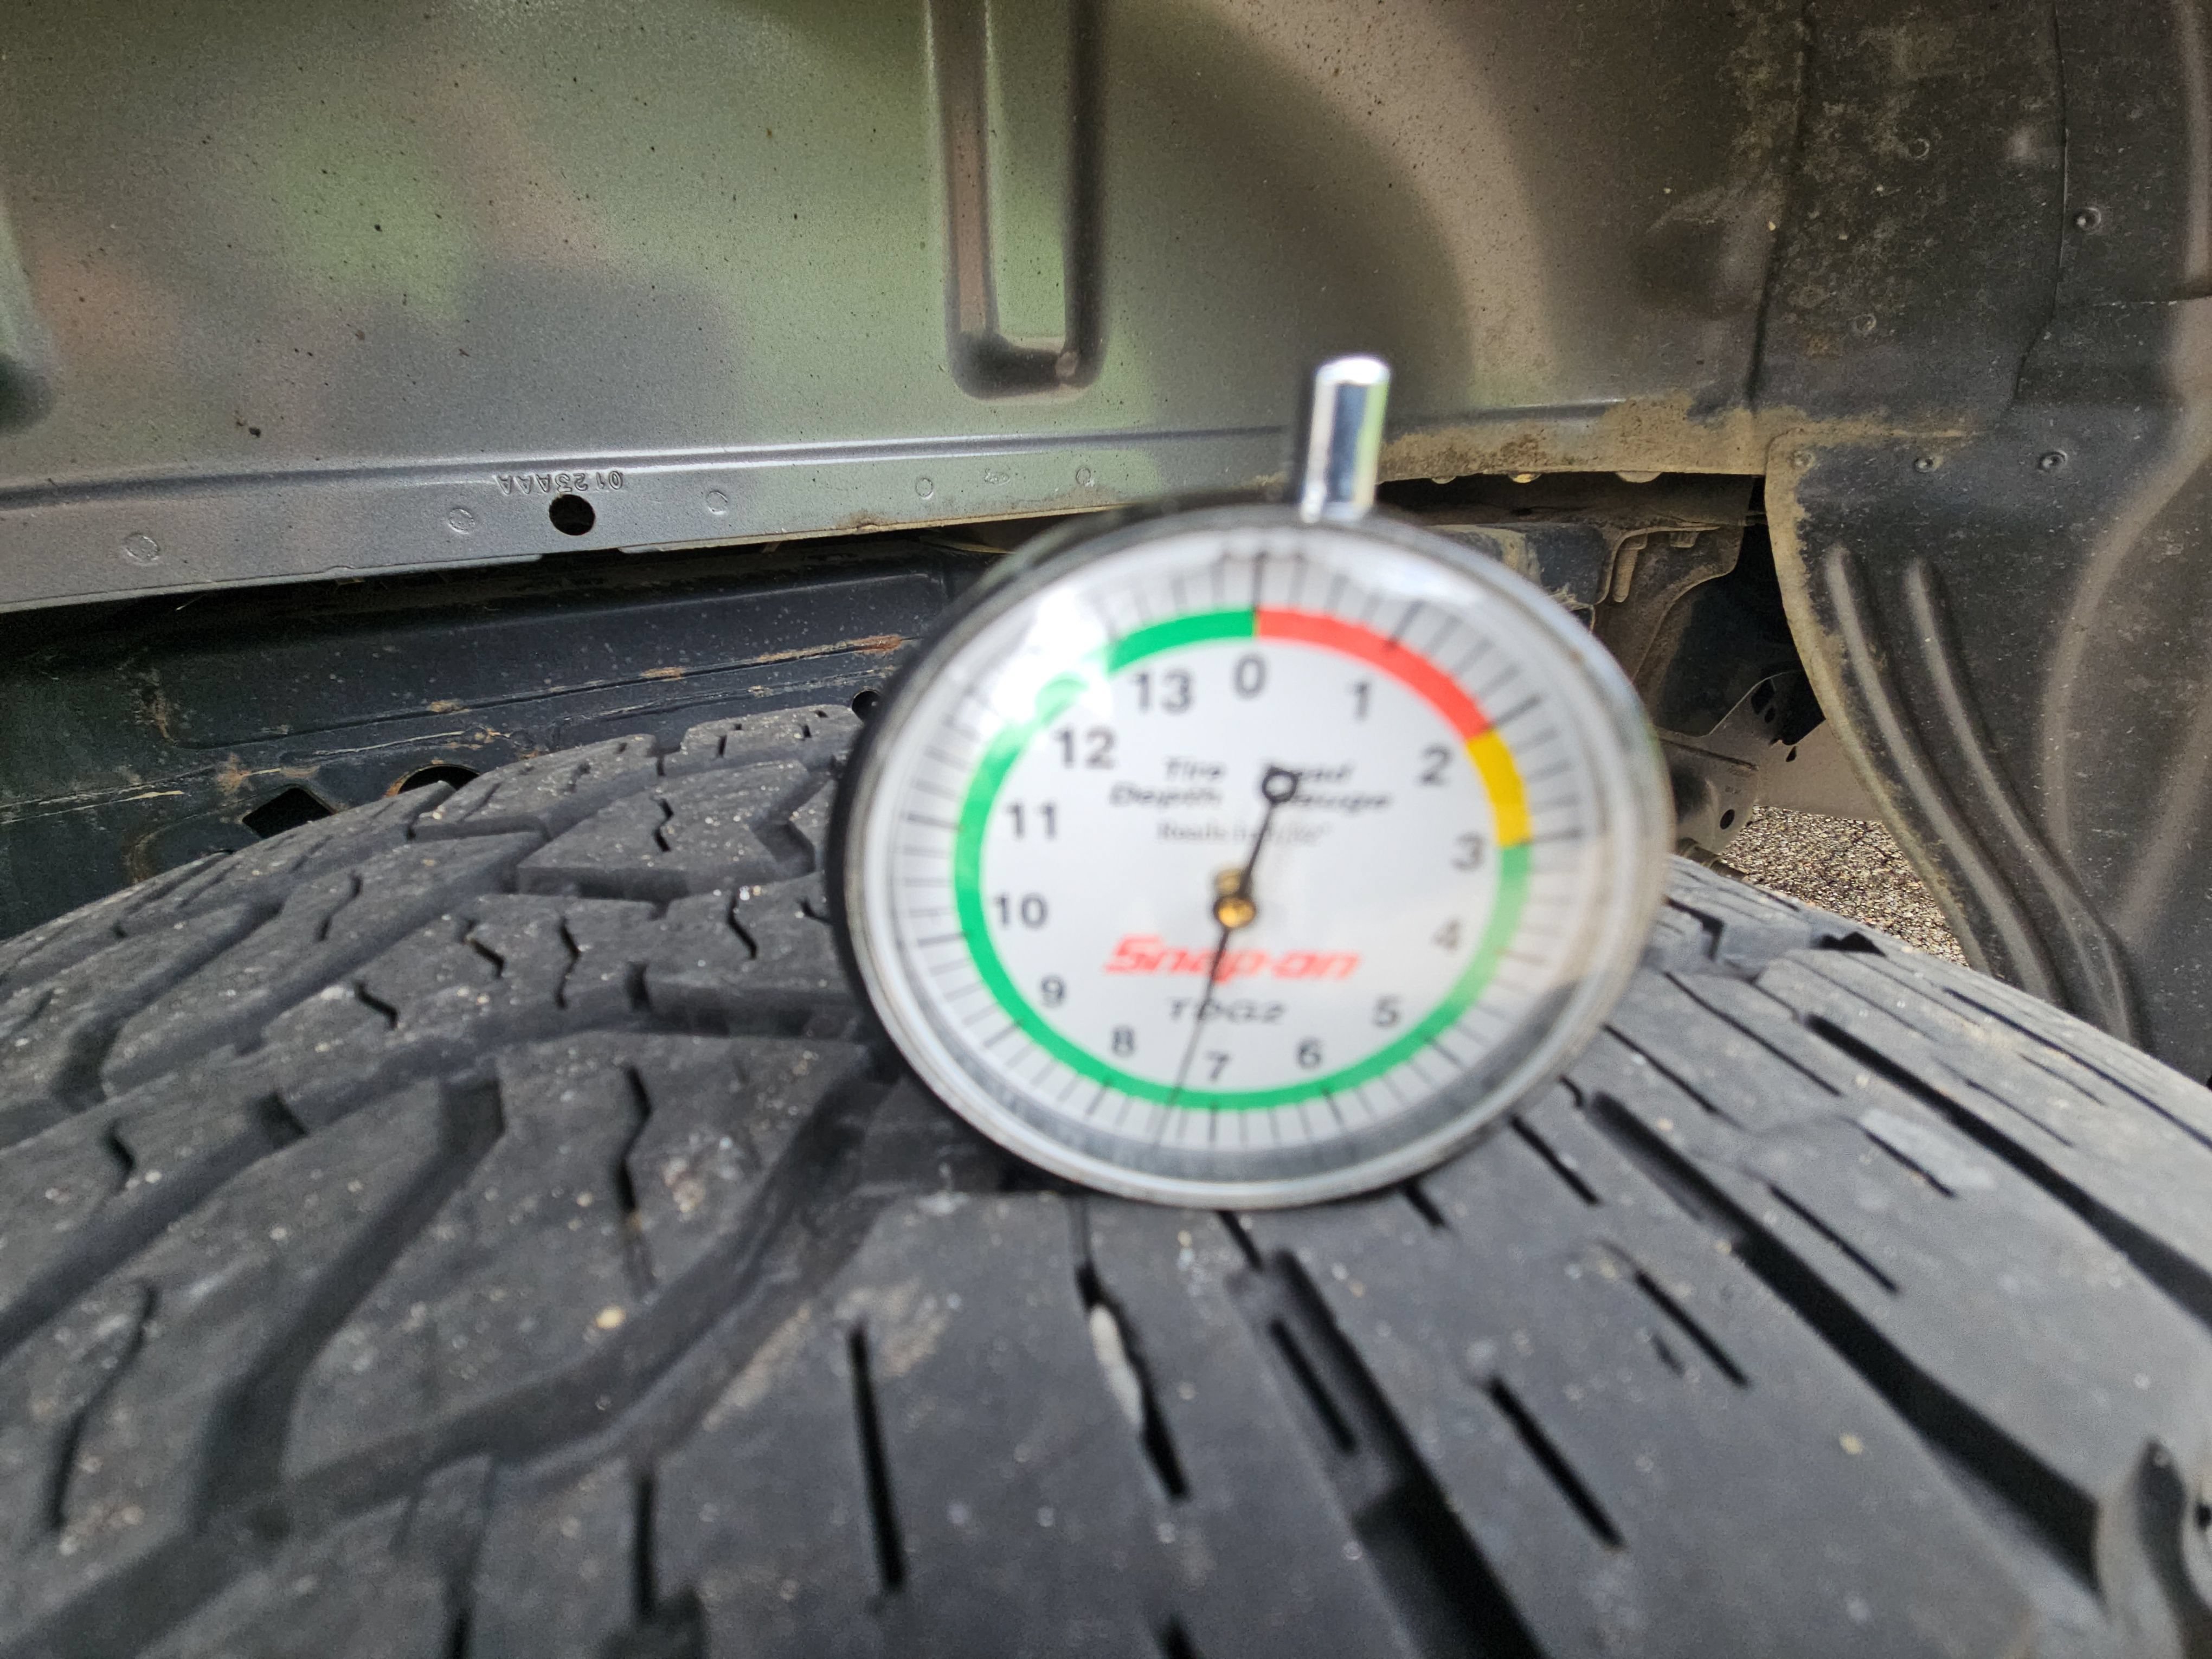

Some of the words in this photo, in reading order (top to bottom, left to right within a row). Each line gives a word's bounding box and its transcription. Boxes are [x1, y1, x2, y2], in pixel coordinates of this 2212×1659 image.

[492, 470, 623, 495] 0123AAA
[1134, 671, 1195, 711] 13
[1234, 654, 1266, 698] 0
[1349, 680, 1372, 720] 1
[1055, 728, 1116, 769] 12
[1419, 747, 1455, 784] 2
[1006, 802, 1057, 838] 11
[1455, 834, 1486, 870] 3
[995, 893, 1047, 929] 10
[1433, 918, 1461, 952] 4
[1103, 934, 1361, 984] Snap-on
[1041, 977, 1067, 1007] 9
[1373, 995, 1401, 1028] 5
[1111, 1026, 1136, 1057] 8
[1297, 1038, 1323, 1069] 6
[1206, 1051, 1231, 1082] 7
